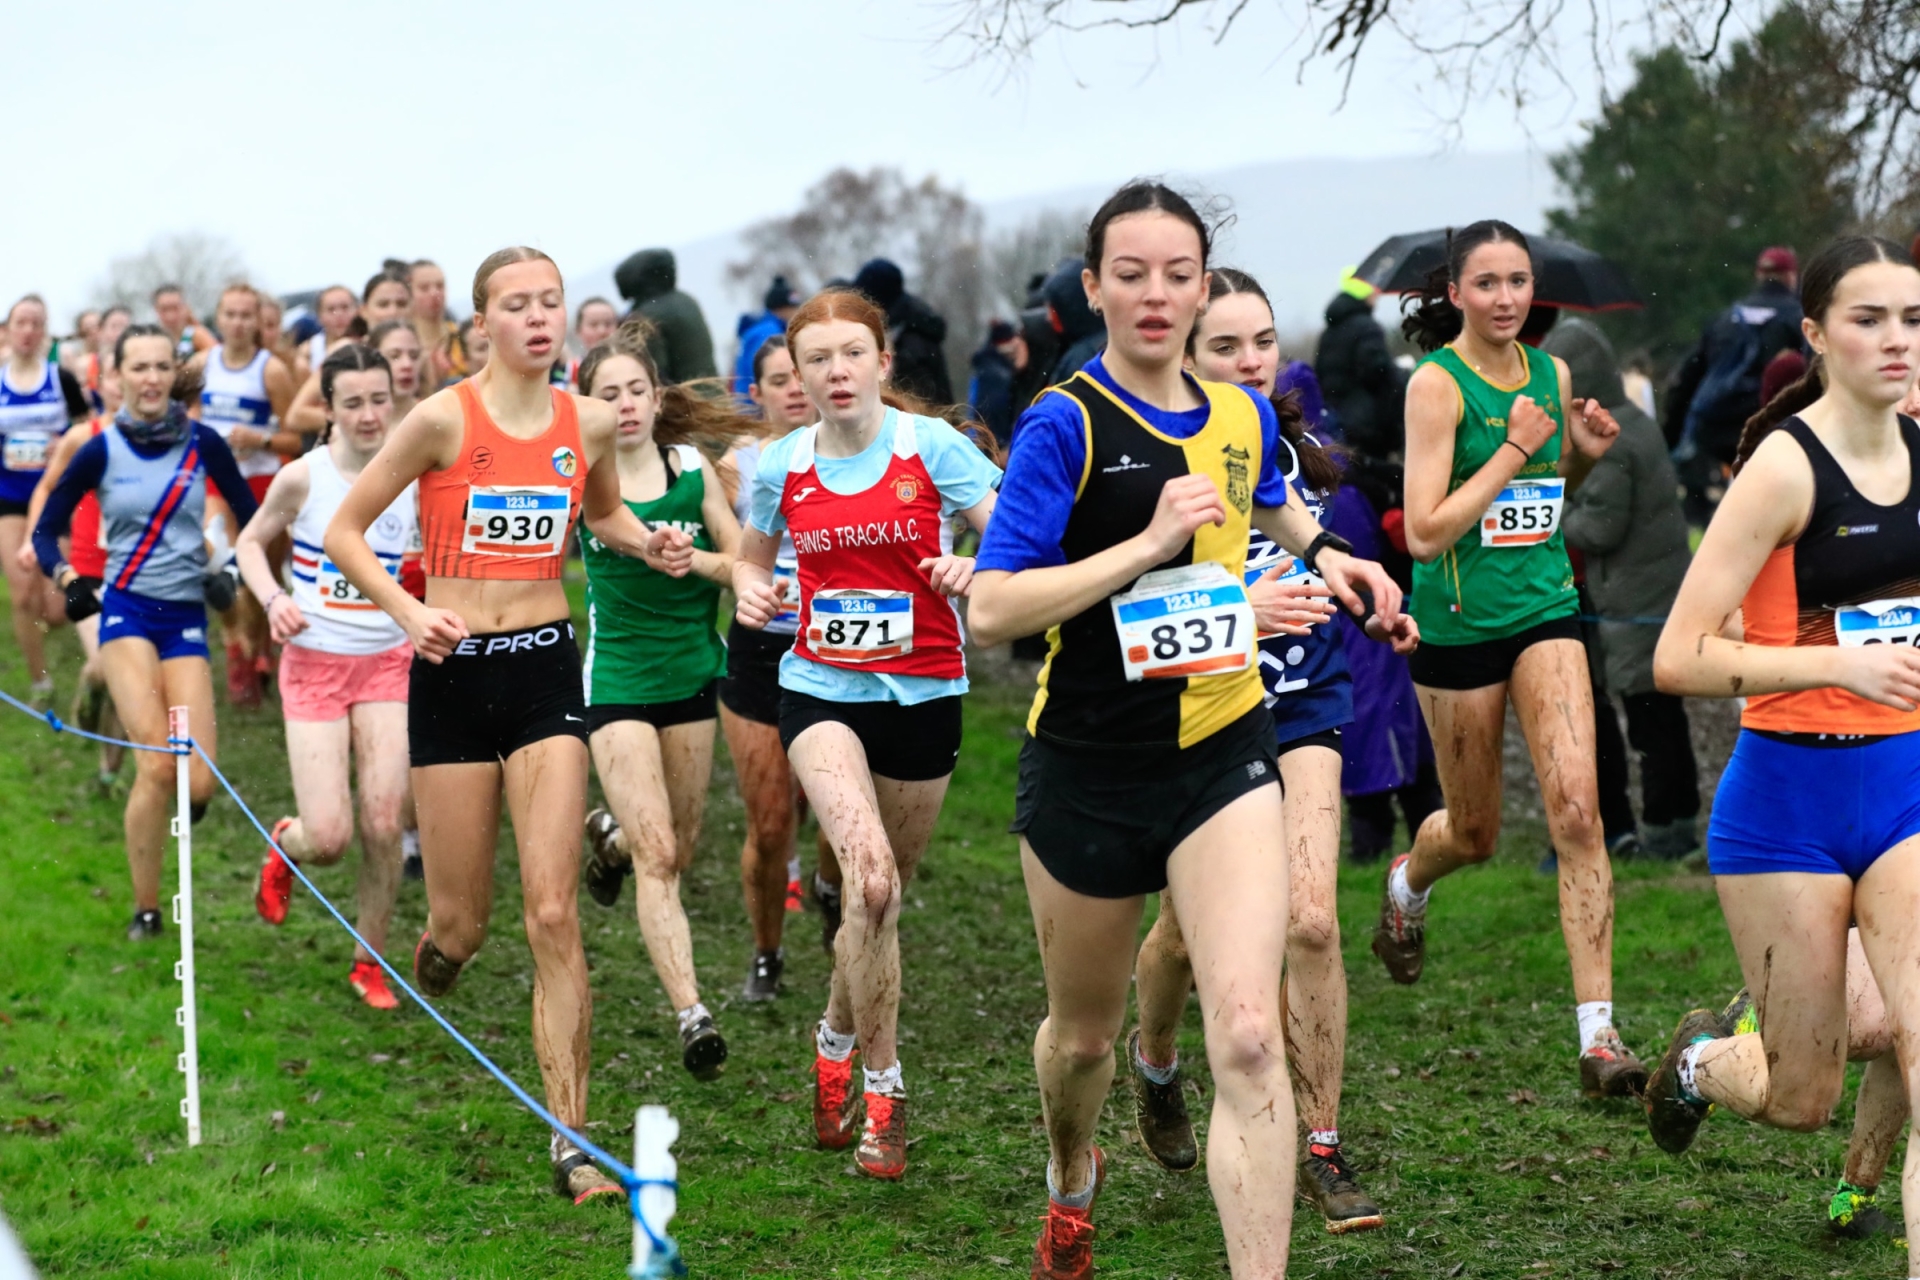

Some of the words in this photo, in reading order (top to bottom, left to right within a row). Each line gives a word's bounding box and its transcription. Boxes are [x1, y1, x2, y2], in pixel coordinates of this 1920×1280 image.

[505, 497, 539, 509] 123.ie
[1513, 488, 1541, 500] 123.ie
[487, 515, 554, 541] 930
[1500, 505, 1554, 531] 853
[834, 521, 890, 549] TRACK
[893, 518, 922, 543] A.C.
[840, 600, 876, 612] 123.ie
[1163, 591, 1212, 613] 123.ie
[1877, 610, 1913, 627] 123.ie
[484, 627, 559, 655] PRO
[825, 619, 895, 646] 871
[1151, 613, 1237, 661] 837
